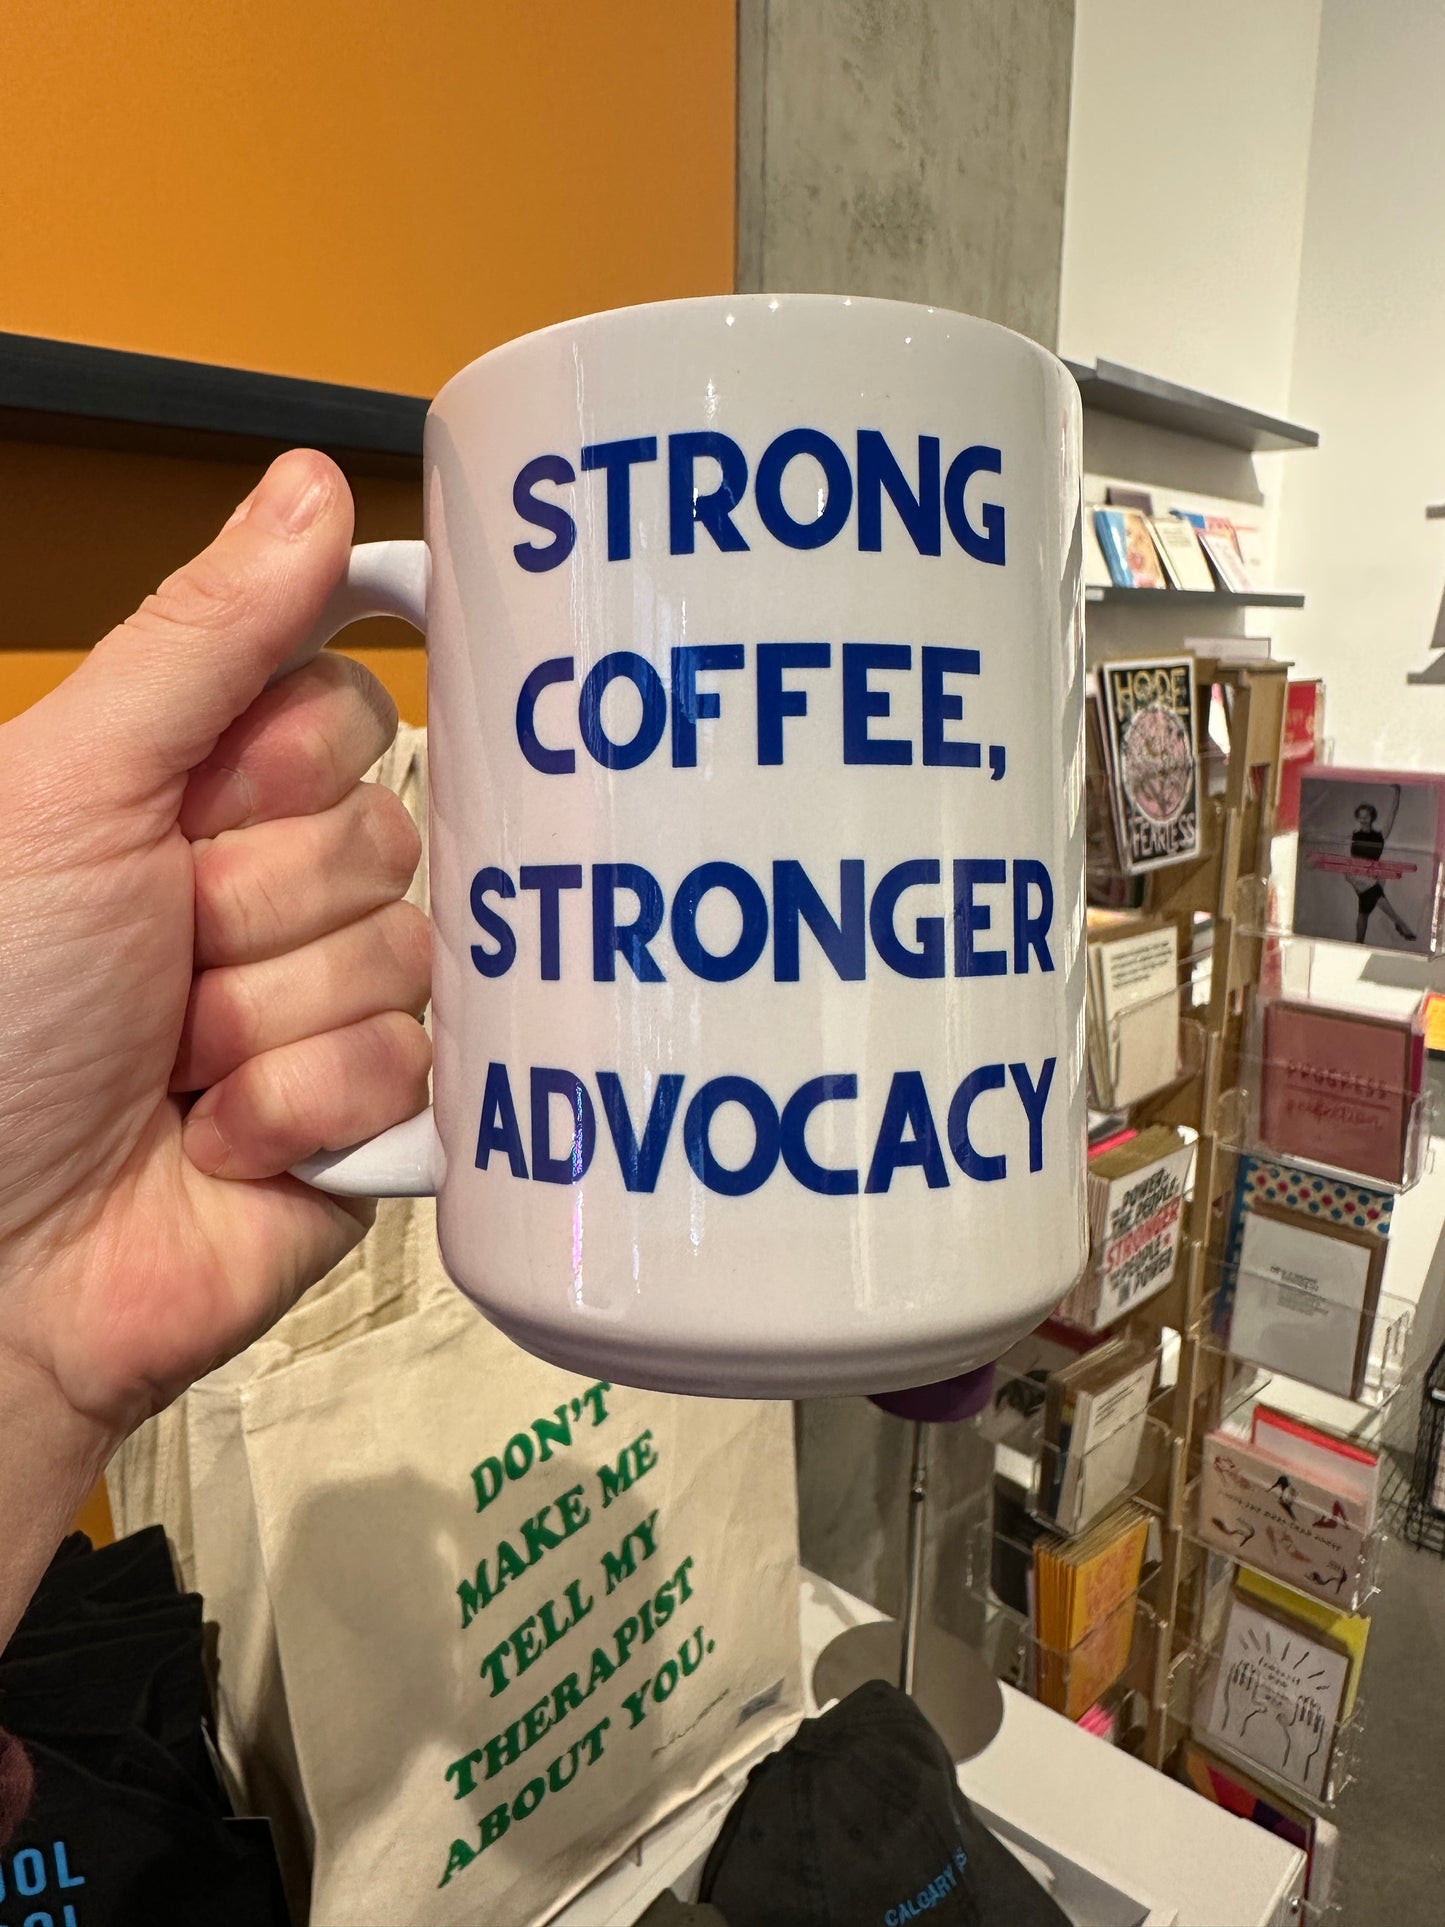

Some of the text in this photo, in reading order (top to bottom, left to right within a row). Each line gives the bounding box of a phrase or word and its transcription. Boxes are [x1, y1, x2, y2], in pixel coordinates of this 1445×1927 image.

[513, 428, 1006, 572] STRONG
[516, 643, 1006, 781] COFFEE,
[470, 859, 1055, 983] STRONGER
[475, 1057, 1056, 1197] ADVOCACY
[471, 1381, 611, 1513] DON'T
[456, 1430, 660, 1628] MAKE ME
[480, 1509, 660, 1697] TELL MY
[445, 1556, 694, 1800] THERAPIST
[438, 1719, 611, 1889] ABOUT
[621, 1626, 716, 1730] YOU.
[0, 1841, 85, 1903] OL
[884, 1864, 957, 1927] CALGARY
